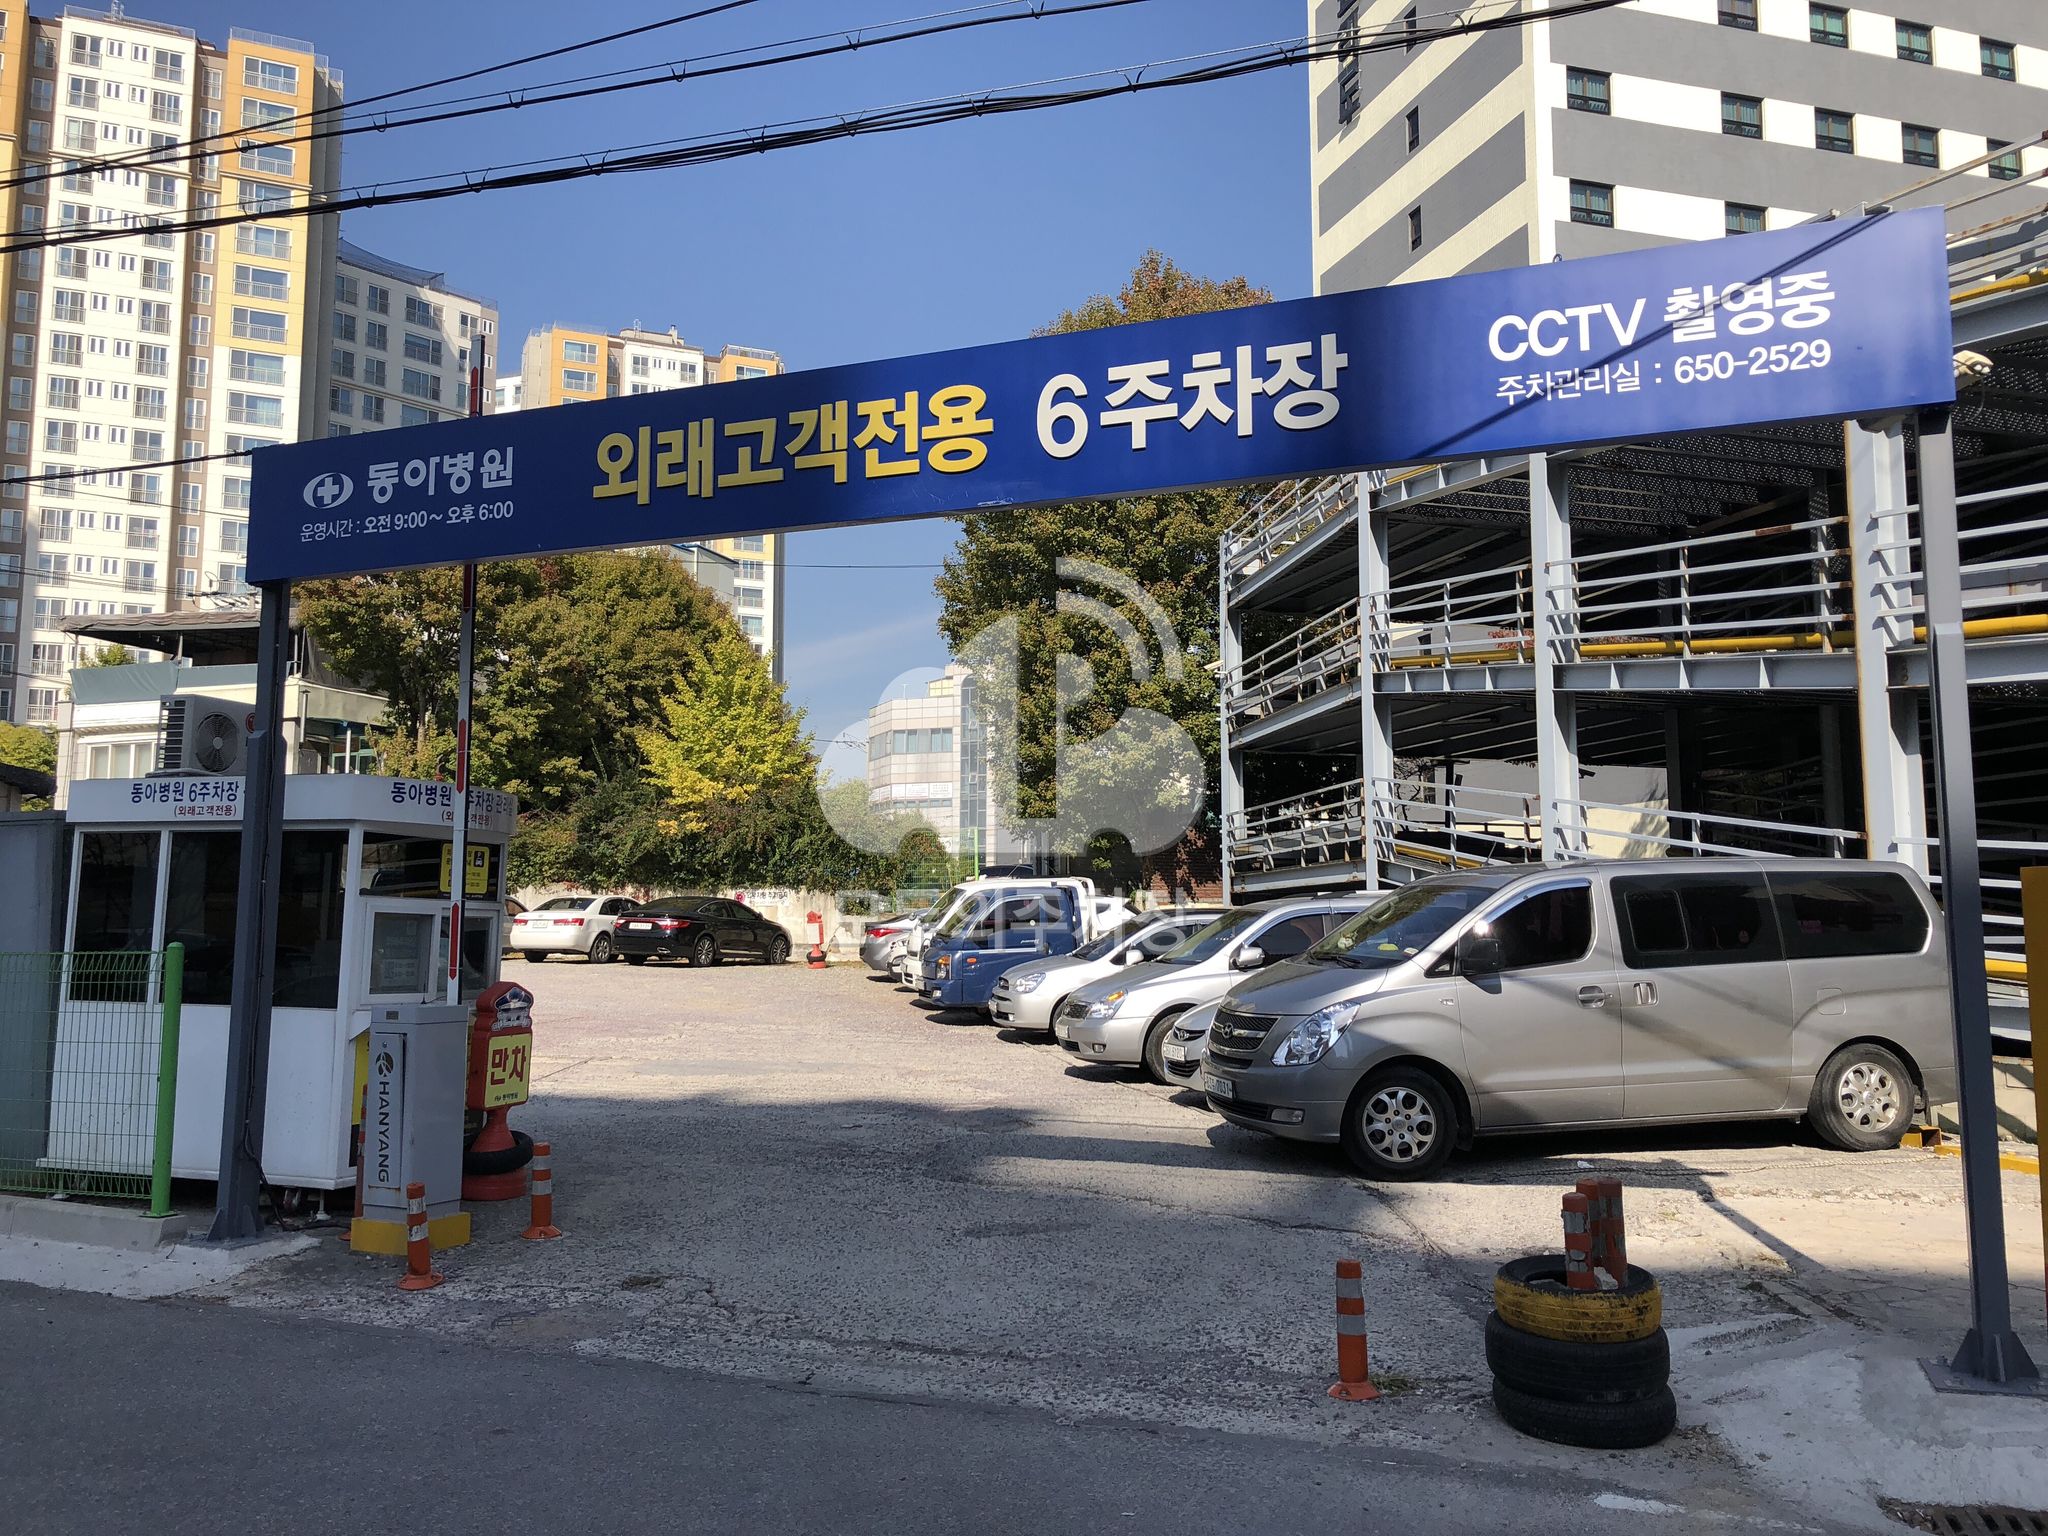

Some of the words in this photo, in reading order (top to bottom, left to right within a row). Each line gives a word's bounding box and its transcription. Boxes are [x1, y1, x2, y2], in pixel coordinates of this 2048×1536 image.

[1488, 298, 1646, 361] CCTV
[1664, 271, 1835, 343] 촬영중
[1496, 360, 1641, 405] 주차관리실
[1674, 339, 1832, 384] 650-2529
[592, 383, 994, 505] 외래고객전용
[1036, 333, 1348, 459] 6주차장
[367, 446, 514, 504] 동아병원
[300, 519, 352, 542] 운영시간
[363, 513, 391, 534] 오전
[446, 503, 475, 525] 오후
[478, 500, 514, 521] 6:00
[131, 781, 185, 803] 동아병원
[189, 781, 239, 802] 6주차장
[174, 804, 237, 817] (외래고객전용)
[391, 782, 451, 807] 동아병원
[491, 1045, 526, 1085] 만차
[378, 1081, 390, 1182] HANYANG
